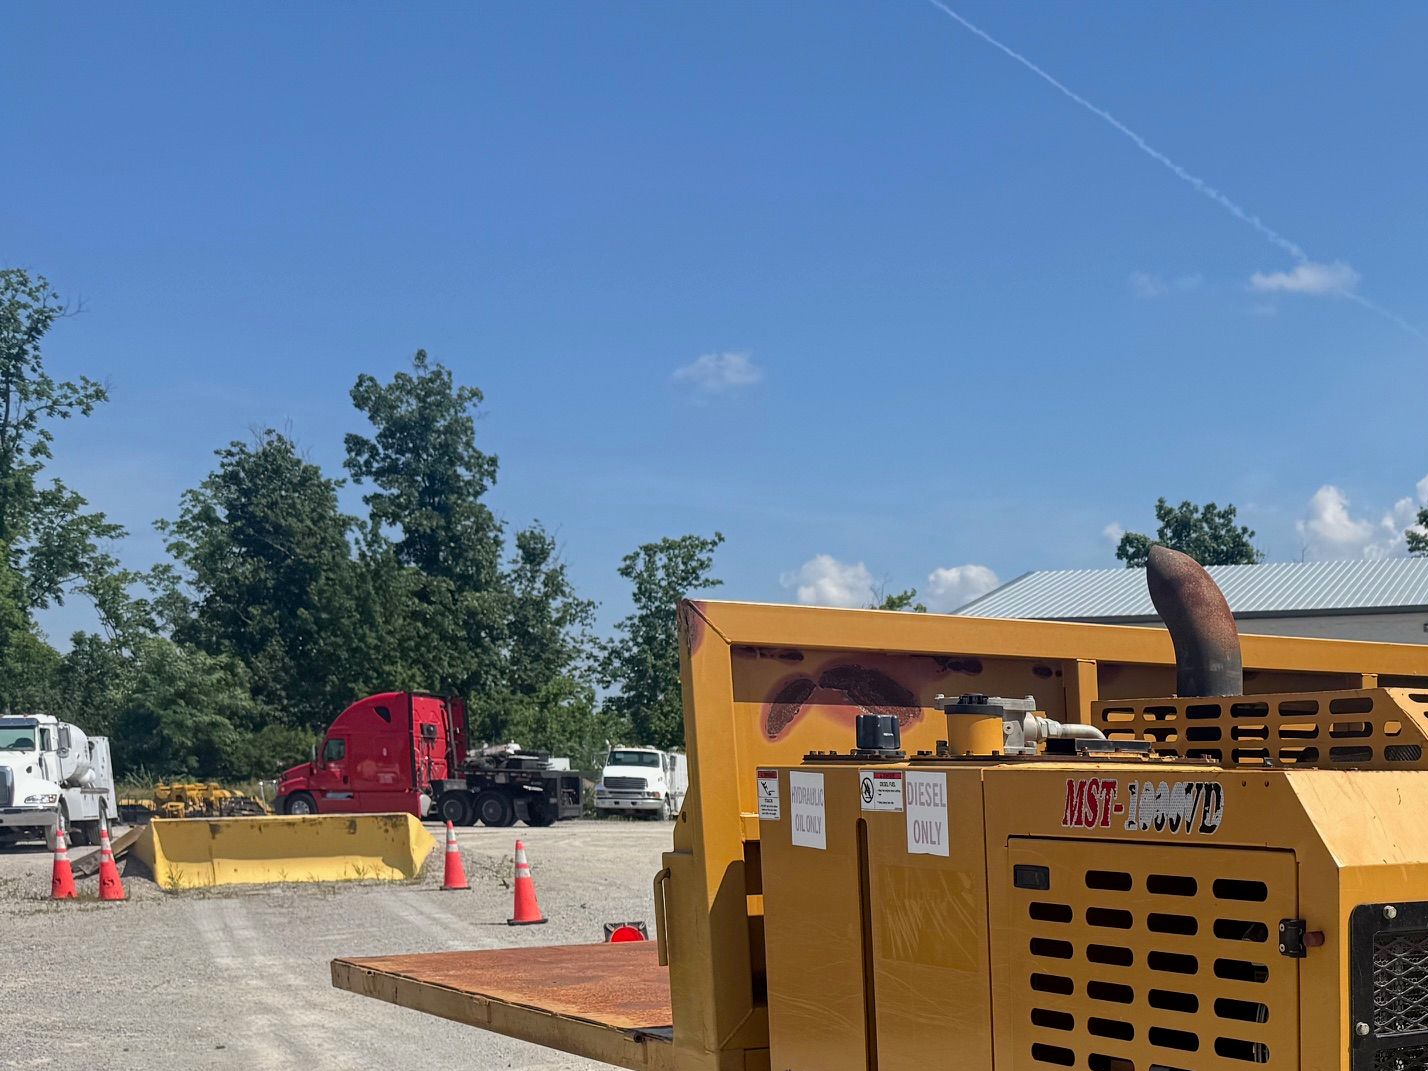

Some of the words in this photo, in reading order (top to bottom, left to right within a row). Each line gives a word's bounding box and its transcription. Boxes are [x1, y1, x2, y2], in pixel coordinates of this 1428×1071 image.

[792, 786, 824, 807] HYDRAULIC
[907, 781, 946, 808] DIESEL
[795, 814, 805, 833] OIL
[806, 815, 821, 834] ONLY
[913, 819, 942, 846] ONLY
